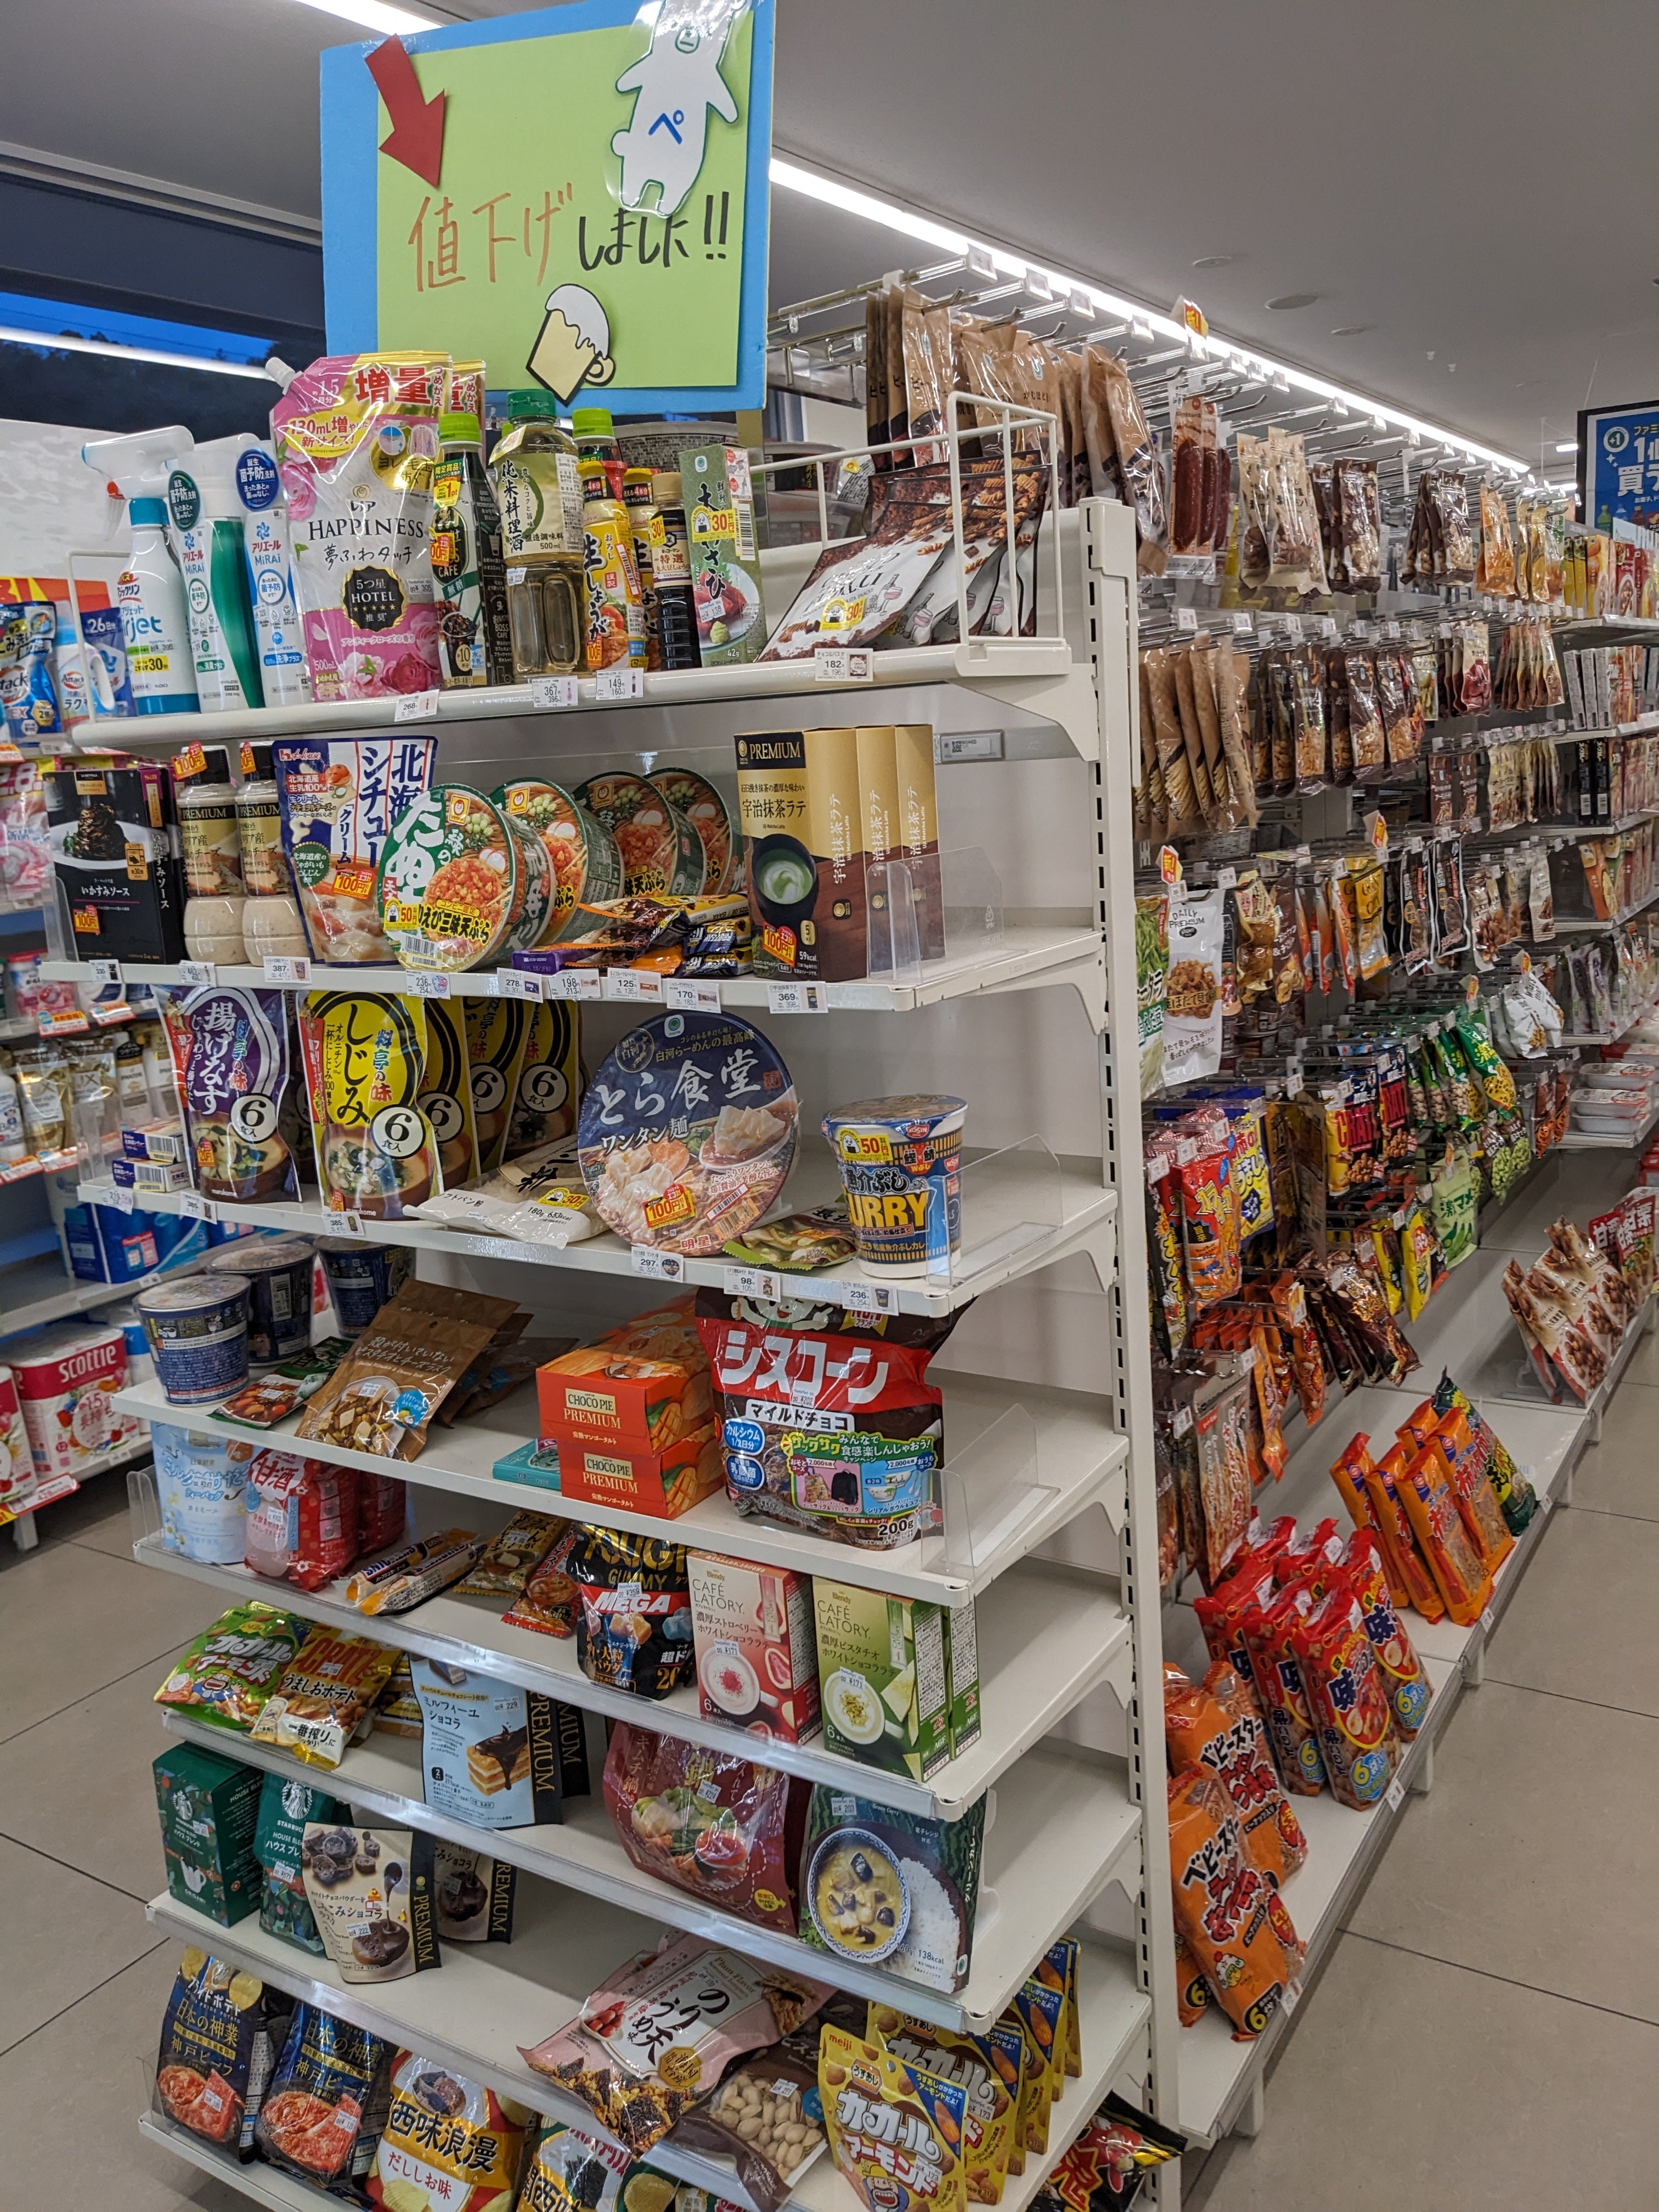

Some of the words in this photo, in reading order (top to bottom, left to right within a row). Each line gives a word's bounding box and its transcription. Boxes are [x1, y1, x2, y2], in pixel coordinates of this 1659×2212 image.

[355, 366, 432, 407] 増量
[433, 365, 444, 408] つめかえ
[466, 374, 476, 414] つめかえ
[501, 458, 524, 553] 純米料理酒
[308, 517, 424, 542] HAPPINESS
[182, 550, 205, 563] アリエール
[252, 540, 282, 554] アリエール
[324, 545, 414, 571] 夢ふわタッチ
[606, 534, 615, 560] おろし
[659, 553, 685, 563] 特選
[438, 566, 459, 577] CAFE
[356, 578, 386, 590] 5つ星
[351, 591, 396, 603] HOTEL
[315, 659, 337, 671] 500mL
[726, 649, 740, 659] 42g
[749, 741, 802, 760] PREMIUM
[289, 775, 319, 784] 北海道産
[183, 807, 227, 820] PREMIUM
[358, 746, 391, 868] シチュー
[742, 798, 806, 819] 宇治抹茶ラテ
[828, 793, 848, 885] 宇治抹茶ラテ
[869, 789, 885, 878] 宇治抹茶ラテ
[907, 785, 924, 871] 宇治抹茶ラテ
[152, 833, 170, 909] いかすみソース
[81, 886, 131, 898] いかすみソース
[1171, 909, 1199, 921] DAILY
[799, 951, 817, 962] 59kcal
[655, 1029, 756, 1063] 白河らーめんの最高峰
[193, 1001, 237, 1116] 揚げなす
[336, 1002, 373, 1126] しじみ
[370, 1029, 394, 1103] 料亭の味
[594, 1047, 762, 1125] とら食堂
[600, 1115, 691, 1155] ワンタン麺
[527, 1206, 544, 1218] 180g
[842, 1190, 929, 1229] URRY
[679, 1235, 712, 1251] 明星
[721, 1329, 889, 1404] シスコーン
[568, 1393, 599, 1409] CHOCO
[599, 1400, 614, 1412] PIE
[563, 1408, 622, 1430] PREMIUM
[749, 1403, 850, 1432] マイルドチョコ
[572, 1430, 618, 1445] 完熟マンゴータルト
[725, 1423, 761, 1442] カルシウム
[839, 1434, 880, 1446] みんなで
[586, 1458, 617, 1474] CHOCO
[617, 1465, 631, 1478] PIE
[843, 1456, 878, 1464] キャンペーン
[254, 1457, 300, 1492] 甘酒
[582, 1471, 639, 1494] PREMIUM
[591, 1492, 635, 1508] 完熟マンゴータルト
[878, 1517, 915, 1536] 200g
[607, 1568, 668, 1591] GUMMY
[706, 1570, 726, 1582] Blendy
[692, 1578, 725, 1599] CAFÉ
[832, 1591, 851, 1605] Blendy
[594, 1591, 672, 1614] MEGA
[817, 1599, 851, 1621] CAFÉ
[696, 1610, 759, 1634] 濃厚ストロベリー
[697, 1624, 770, 1650] ホワイトショコララテ
[821, 1632, 881, 1662] 濃厚ピスタチオ
[283, 1672, 359, 1706] うましおポテト
[422, 1696, 481, 1719] ミルフィーユ
[428, 1709, 461, 1730] ショコラ
[914, 1825, 939, 1838] 電子レンジ
[411, 1893, 435, 1965] PREMIUM
[917, 1949, 945, 1965] 138kcal
[175, 1997, 240, 2049] 日本の神業
[828, 2033, 853, 2051] meiji
[170, 2035, 234, 2078] 神戸ビーフ
[851, 2063, 880, 2088] うすあじ
[915, 2072, 964, 2100] うすあじがかかった
[918, 2081, 959, 2106] アーモンドだよ!
[387, 2149, 454, 2201] だししお味
[844, 2134, 939, 2198] アーモンド
